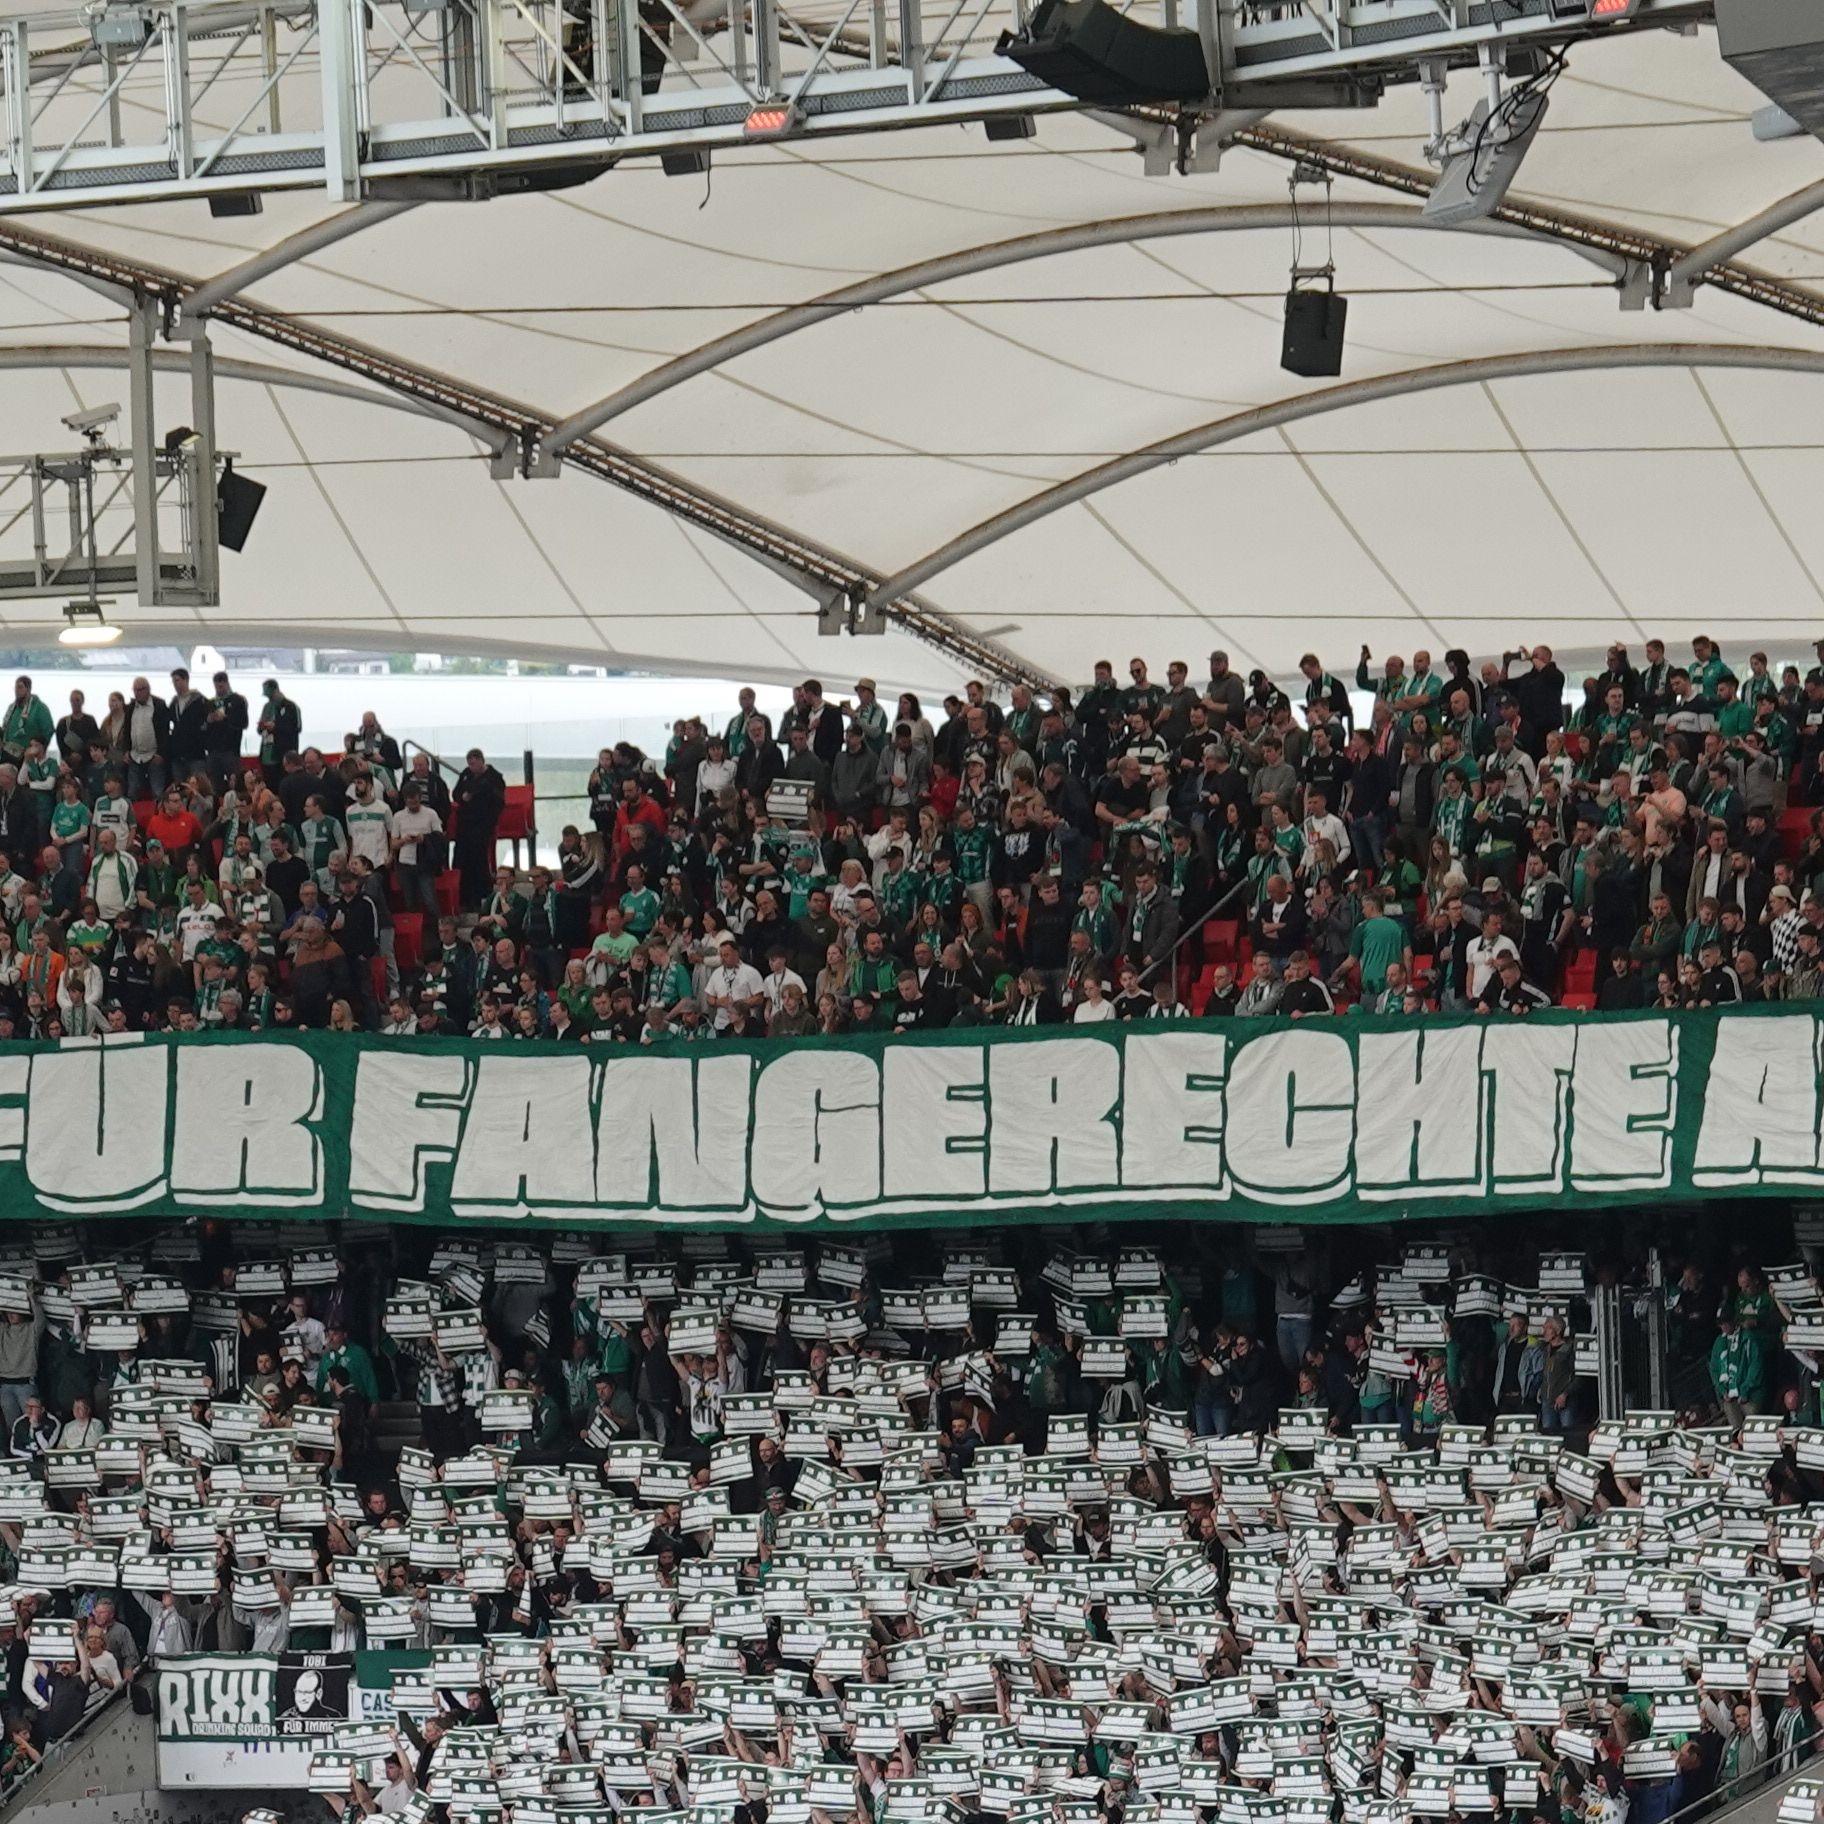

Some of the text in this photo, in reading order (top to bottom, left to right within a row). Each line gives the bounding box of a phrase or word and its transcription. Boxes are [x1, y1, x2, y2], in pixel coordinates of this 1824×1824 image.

[348, 1018, 1678, 1222] FANGERECHTE
[303, 1655, 327, 1667] TOBI
[158, 1670, 270, 1737] RIXX
